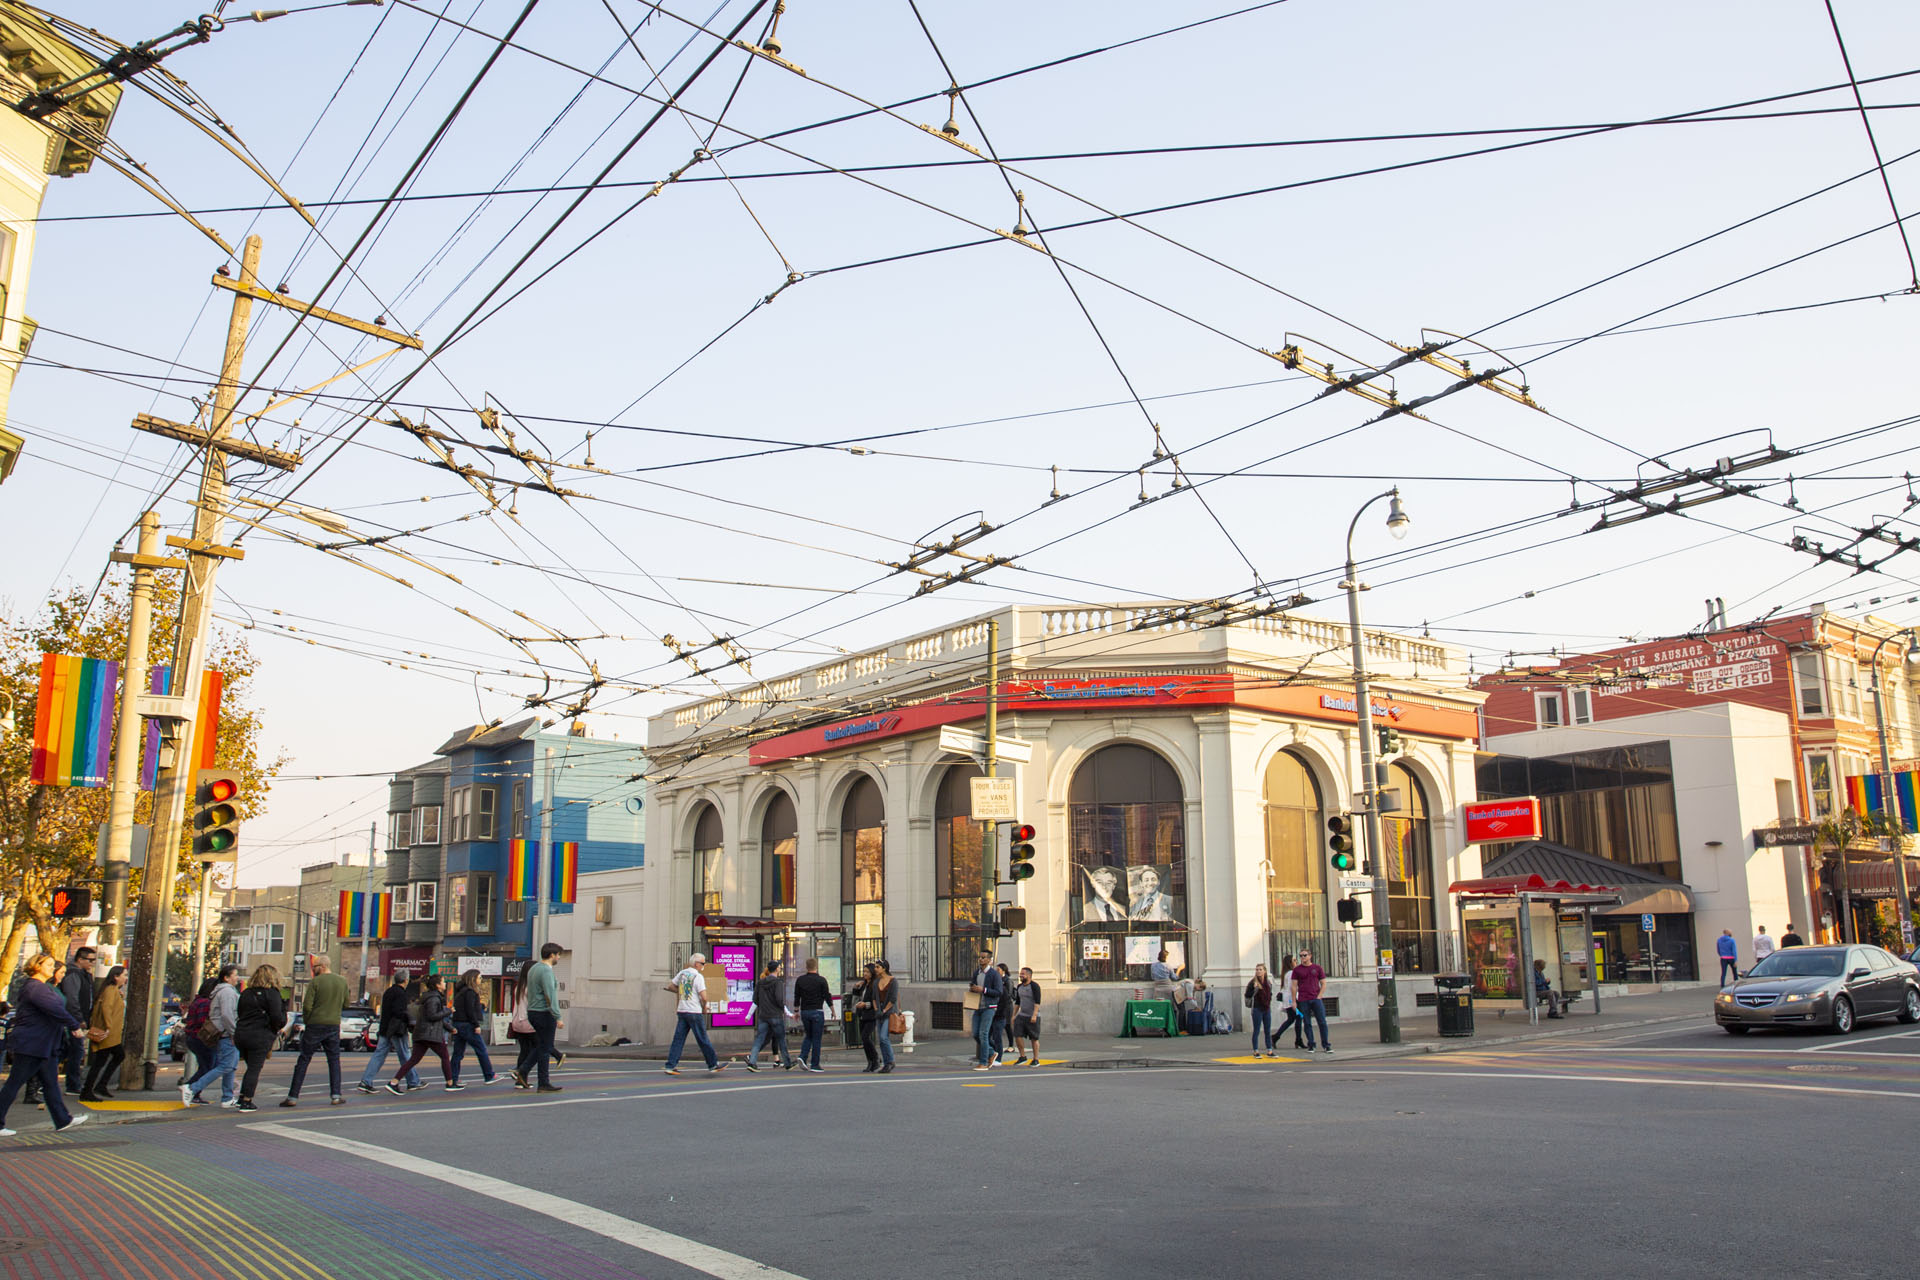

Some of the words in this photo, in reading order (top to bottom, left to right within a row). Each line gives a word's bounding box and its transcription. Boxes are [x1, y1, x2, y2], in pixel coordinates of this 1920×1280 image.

[1624, 656, 1645, 667] THE
[1654, 645, 1703, 662] SAUSAGE
[1713, 634, 1762, 652] FACTORY
[1719, 667, 1734, 677] OUT
[1323, 694, 1346, 711] Bank
[824, 727, 842, 741] Bank
[848, 720, 880, 735] America
[1469, 811, 1487, 820] Bank
[1488, 808, 1495, 818] of
[1496, 806, 1530, 817] America
[1346, 879, 1366, 887] Castro
[465, 957, 494, 965] DASHING
